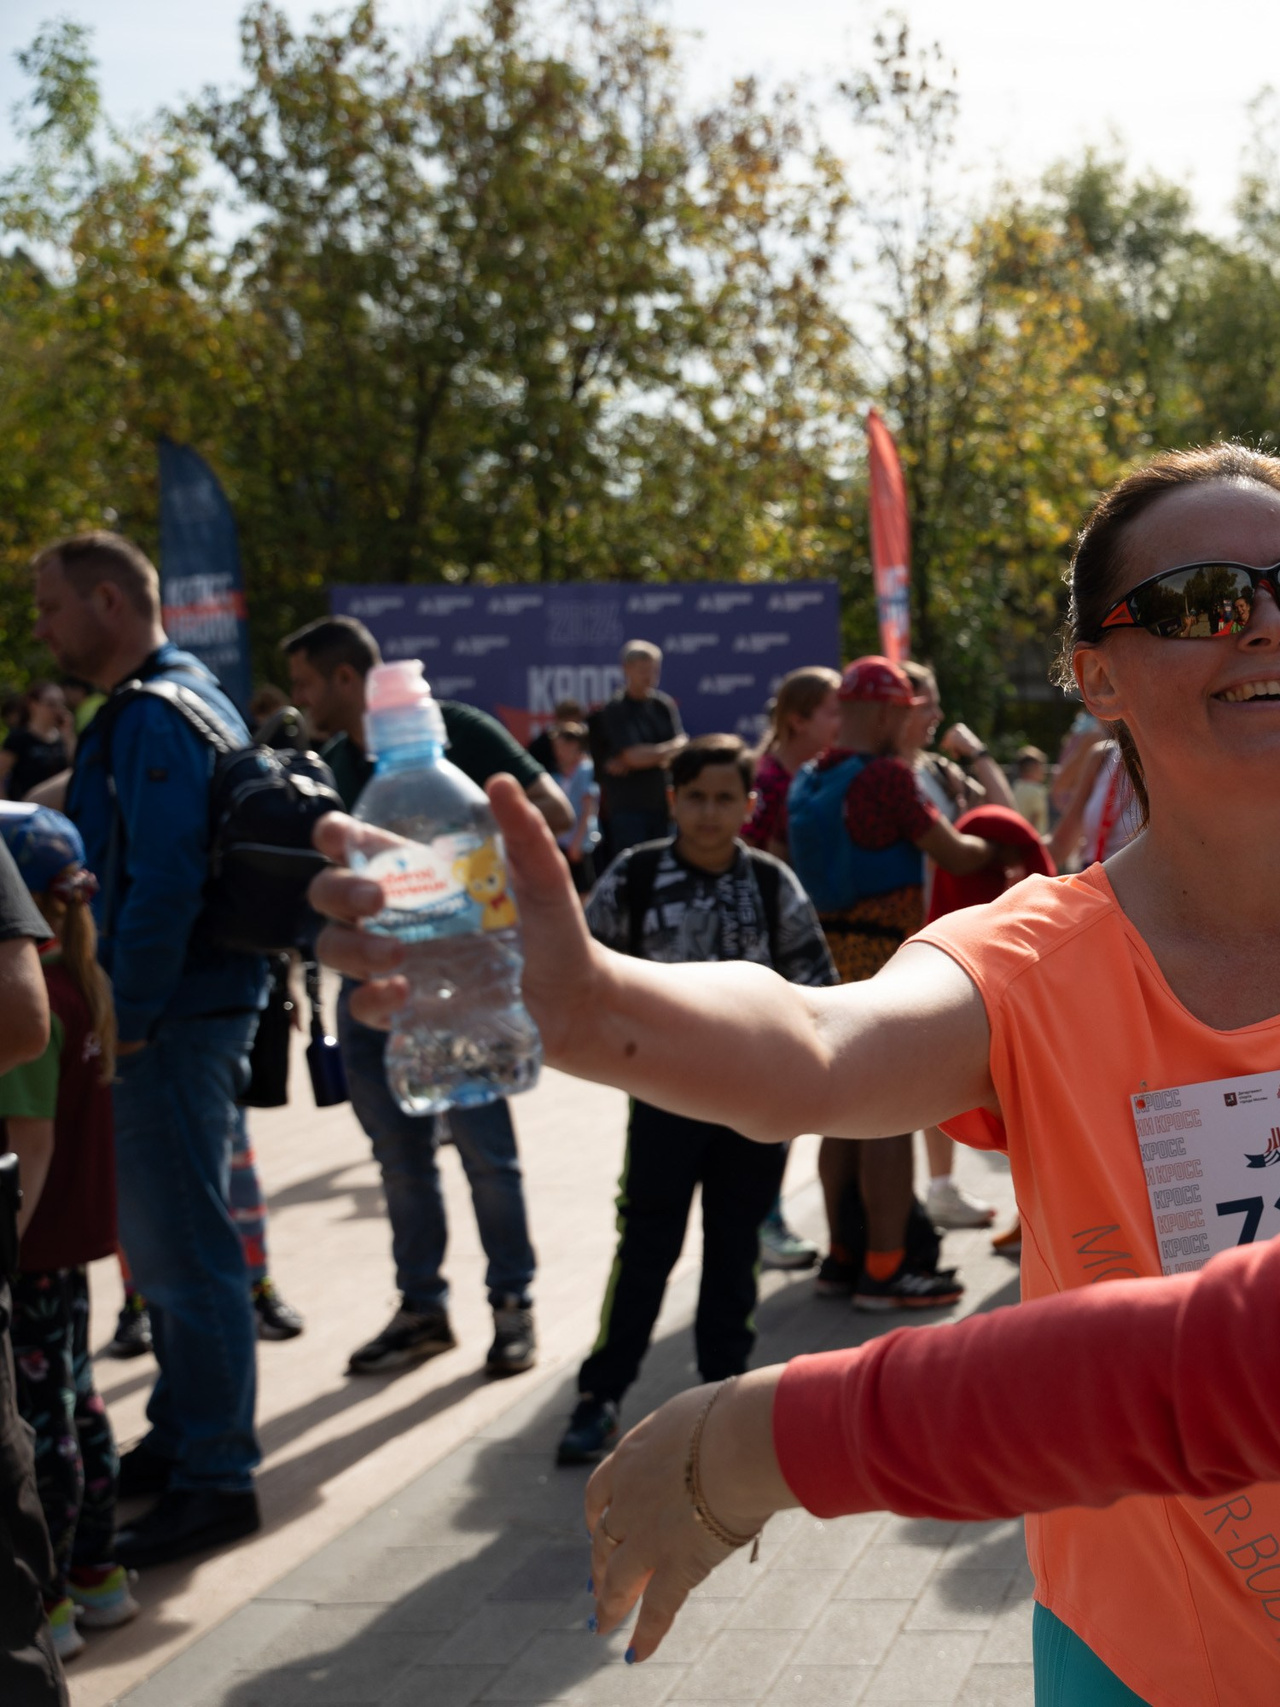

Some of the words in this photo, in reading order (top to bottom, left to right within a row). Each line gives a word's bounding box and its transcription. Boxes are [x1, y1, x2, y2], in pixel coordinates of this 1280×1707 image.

[1155, 1109, 1202, 1134] КРОСС
[1140, 1137, 1187, 1161] КРОСС
[1155, 1159, 1204, 1184] КРОСС
[1153, 1184, 1202, 1209] КРОСС
[1157, 1209, 1206, 1234] КРОСС
[1161, 1233, 1210, 1259] КРОСС
